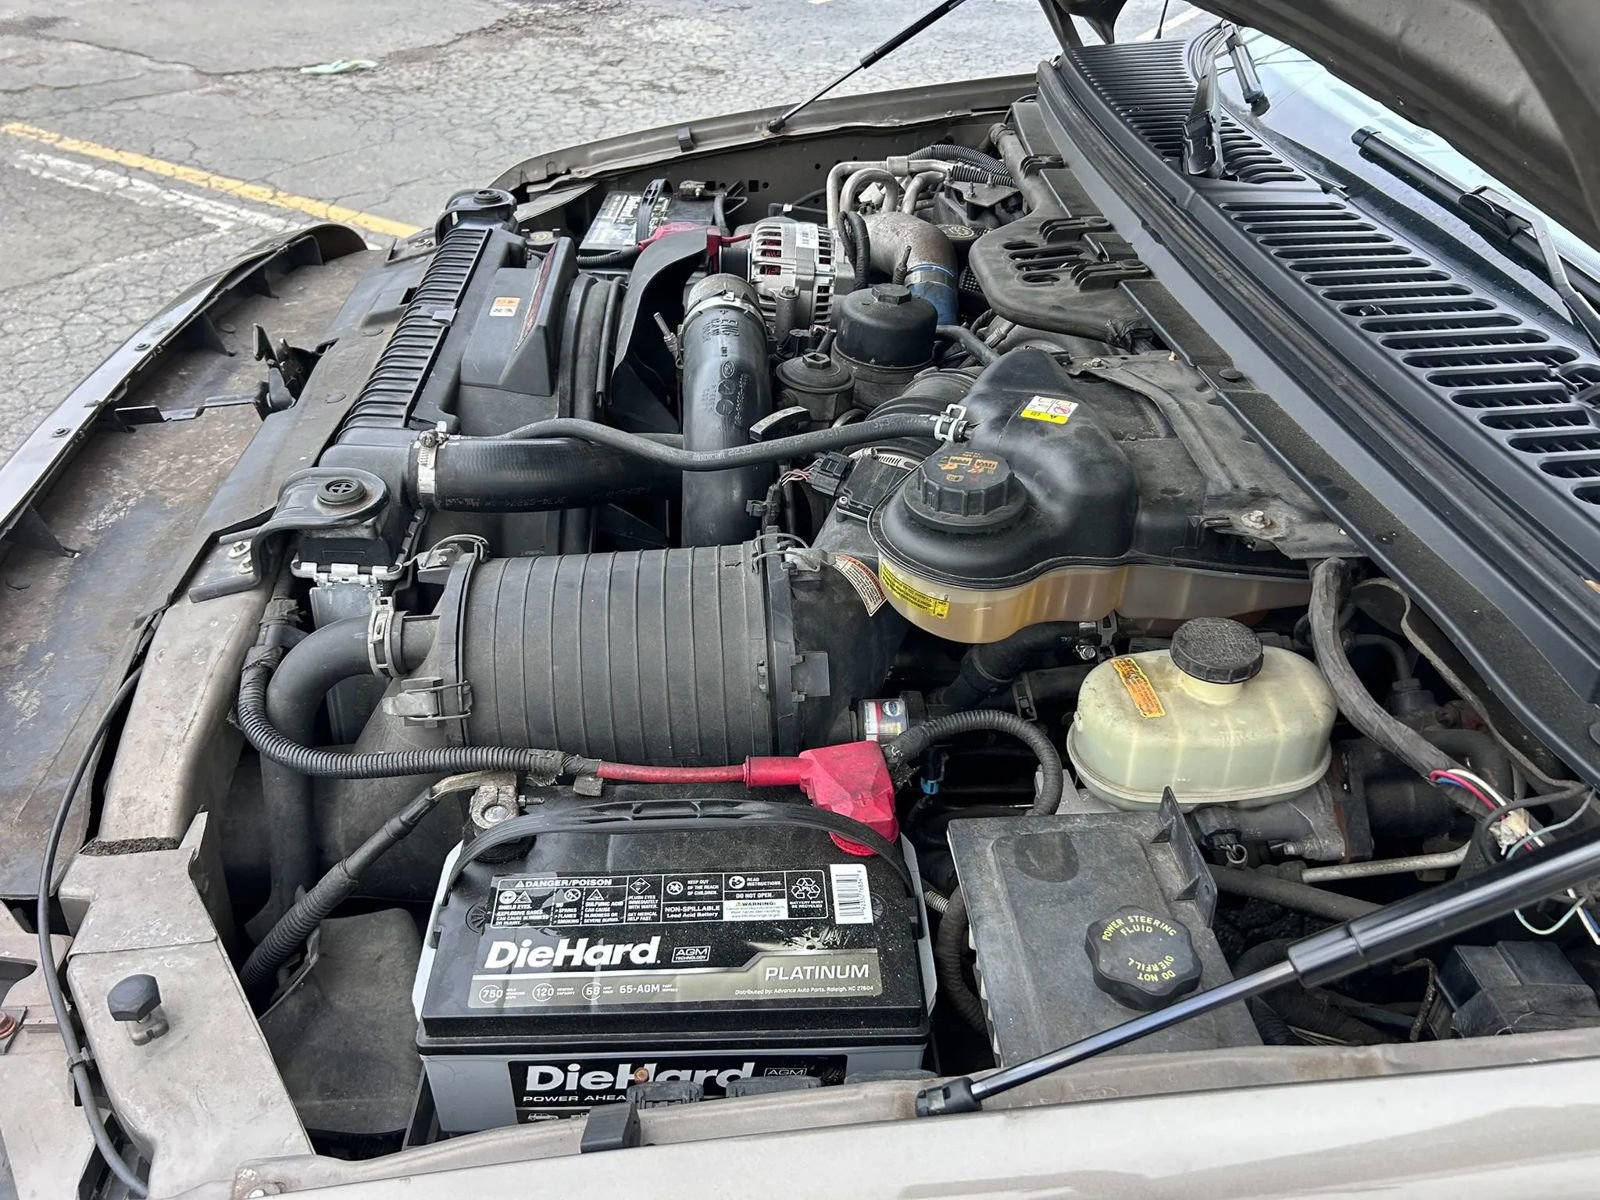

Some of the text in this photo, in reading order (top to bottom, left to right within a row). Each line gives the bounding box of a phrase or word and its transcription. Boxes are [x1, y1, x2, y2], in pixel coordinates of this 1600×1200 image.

[525, 878, 613, 888] DANGER/POISON
[664, 905, 720, 913] NON-SPILLABLE
[1102, 915, 1177, 941] POWER STEERING
[1120, 924, 1153, 936] FLUID
[484, 936, 661, 969] DieHard
[675, 948, 708, 956] AGM
[1127, 954, 1175, 972] OVERFILL
[764, 964, 869, 981] PLATINUM
[1137, 969, 1176, 982] DO NOT
[482, 989, 504, 999] 750
[536, 987, 554, 998] 120
